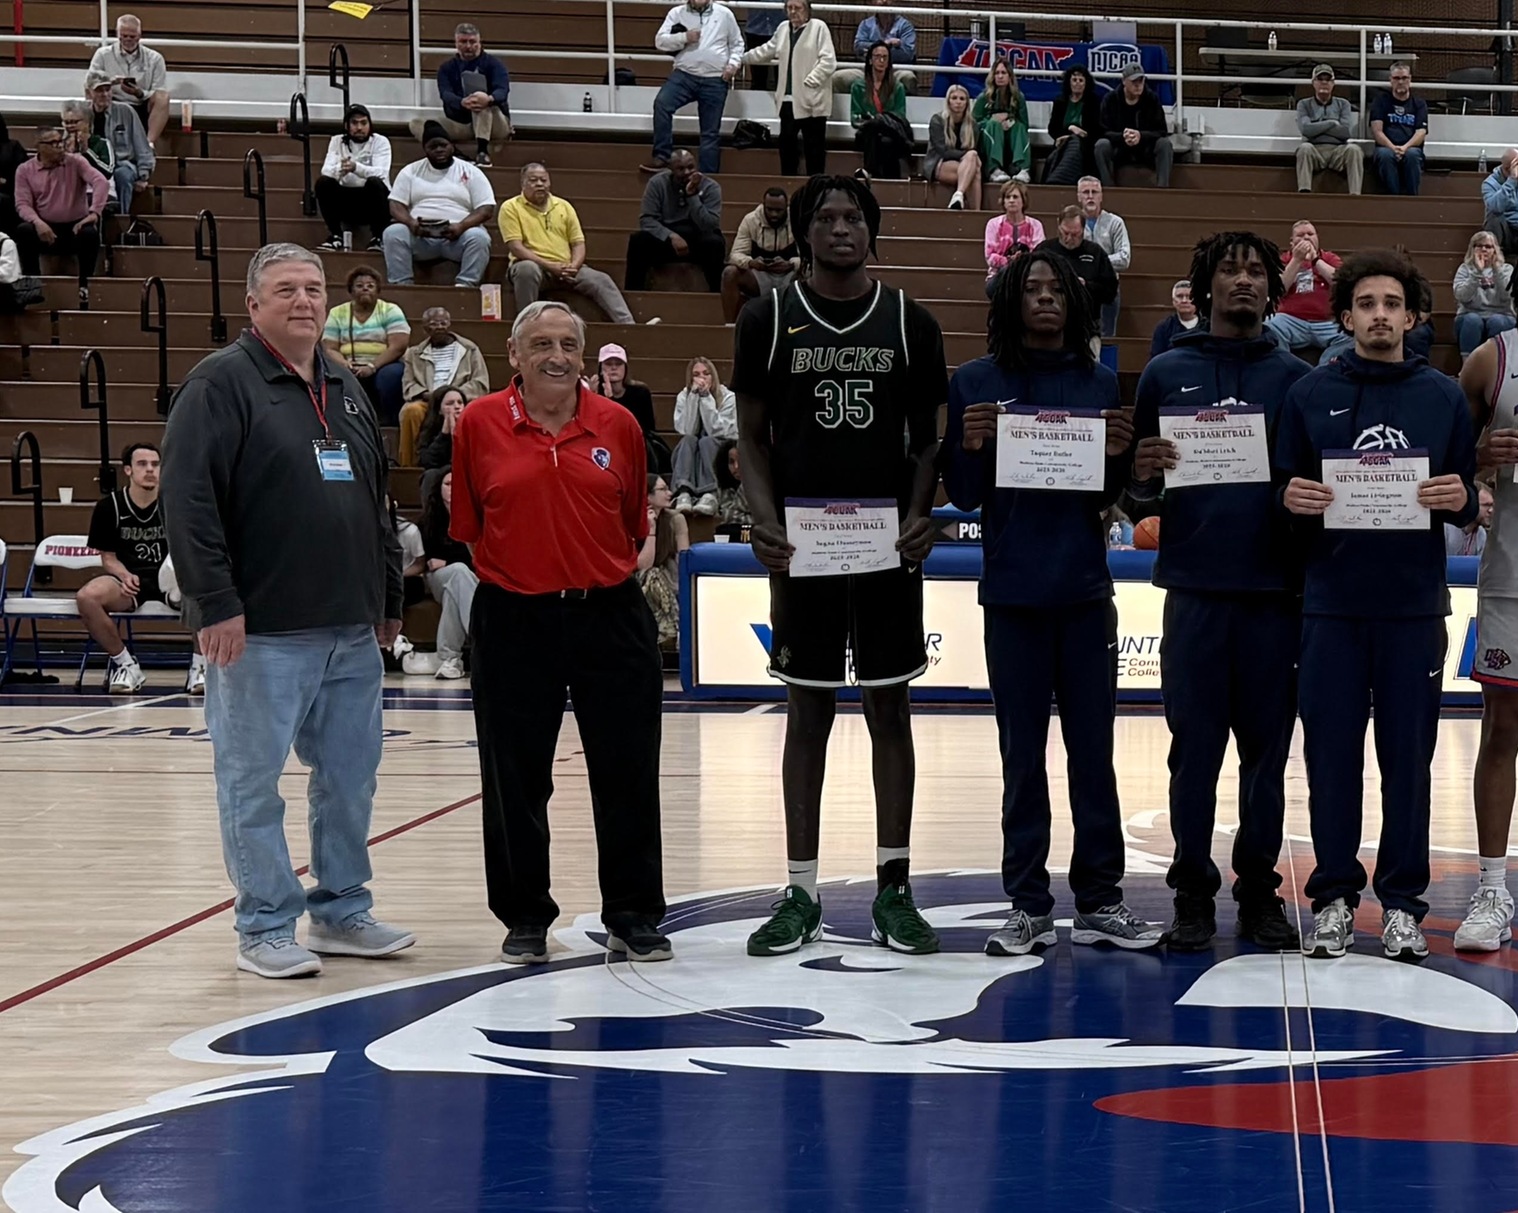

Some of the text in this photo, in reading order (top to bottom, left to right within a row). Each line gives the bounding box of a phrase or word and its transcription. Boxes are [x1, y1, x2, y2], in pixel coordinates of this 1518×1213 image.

[791, 347, 895, 373] BUCKS
[814, 380, 874, 429] 35
[1010, 430, 1094, 442] MEN'S BASKETBALL
[1173, 429, 1255, 439] MEN'S BASKETBALL
[1336, 473, 1418, 483] MEN'S BASKETBALL
[800, 521, 886, 531] MEN'S BASKETBALL
[959, 522, 982, 539] PO
[121, 526, 167, 541] BUCK
[135, 542, 162, 562] 21
[1128, 668, 1160, 677] Colle
